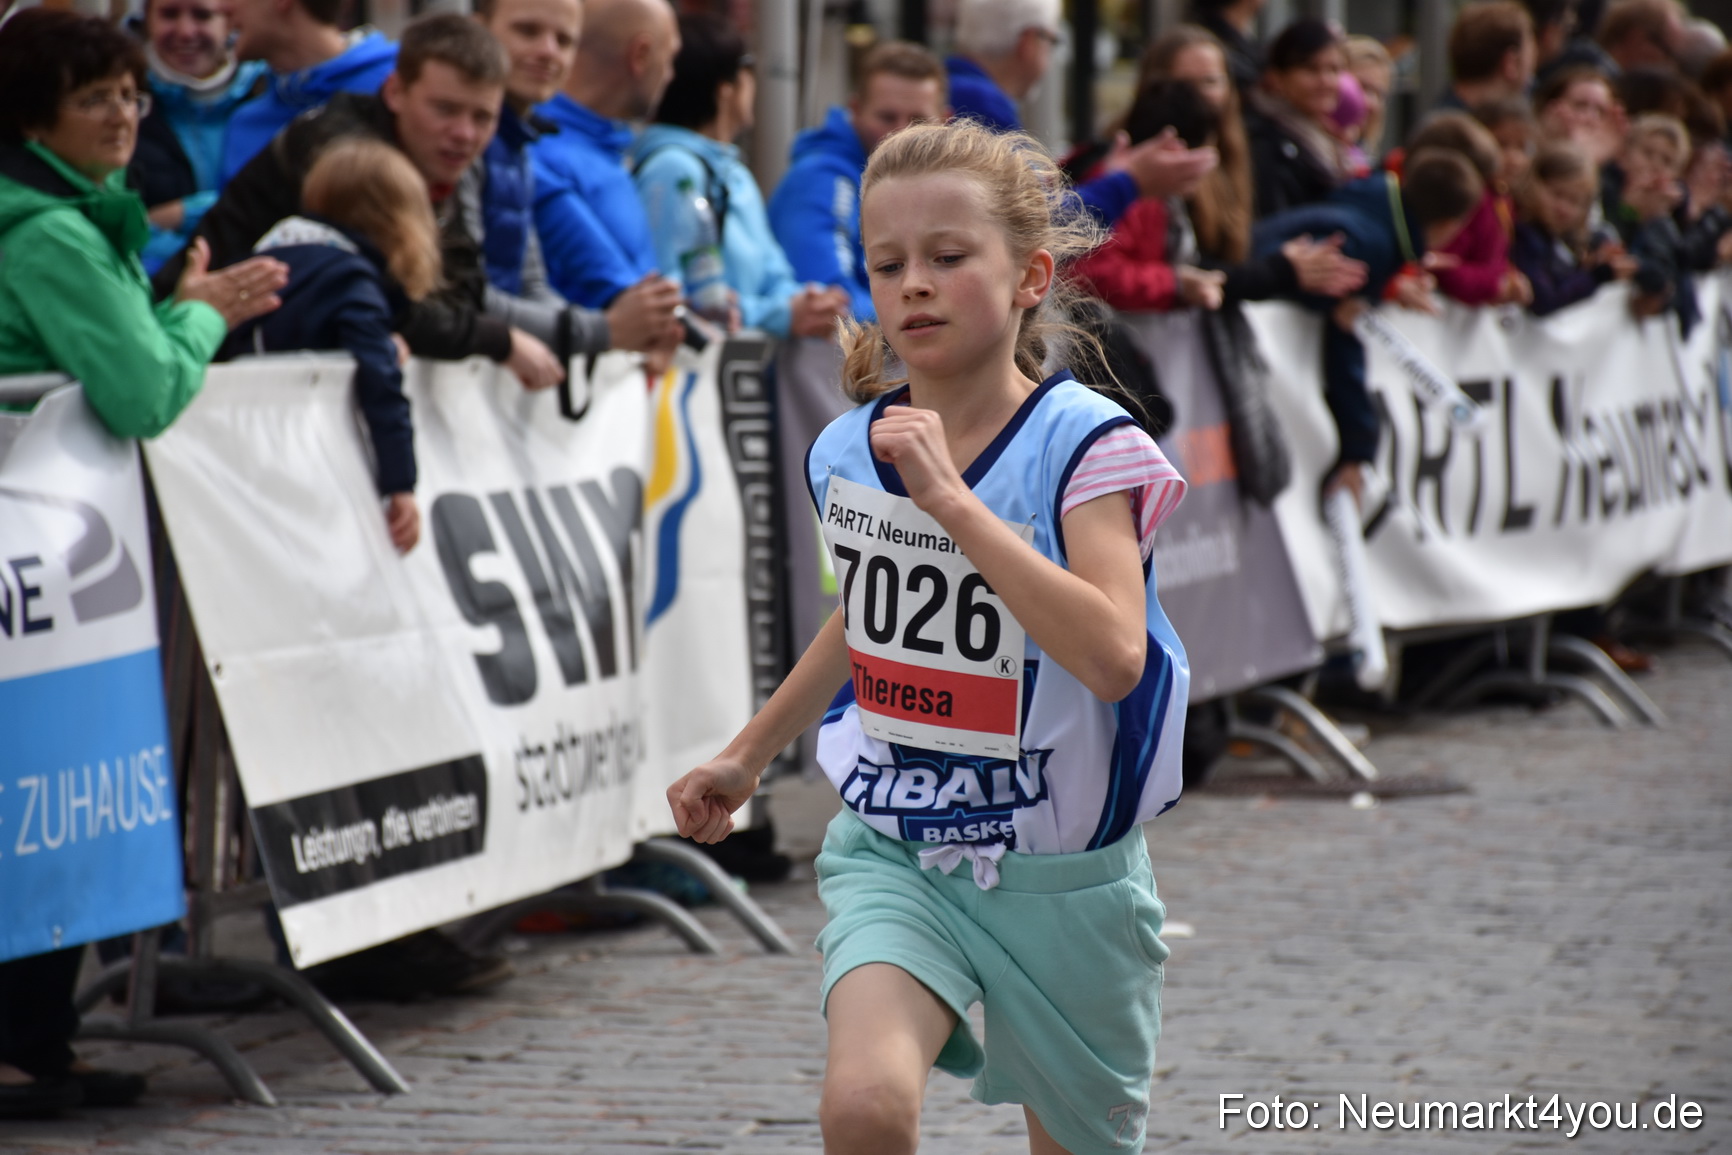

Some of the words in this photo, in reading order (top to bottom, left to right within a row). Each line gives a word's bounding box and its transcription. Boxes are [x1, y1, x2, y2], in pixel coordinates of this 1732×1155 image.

[828, 503, 874, 537] PARTL
[878, 519, 966, 555] Neumar
[834, 543, 1001, 662] 7026
[853, 661, 954, 718] Theresa
[15, 745, 173, 856] ZUHAUSE
